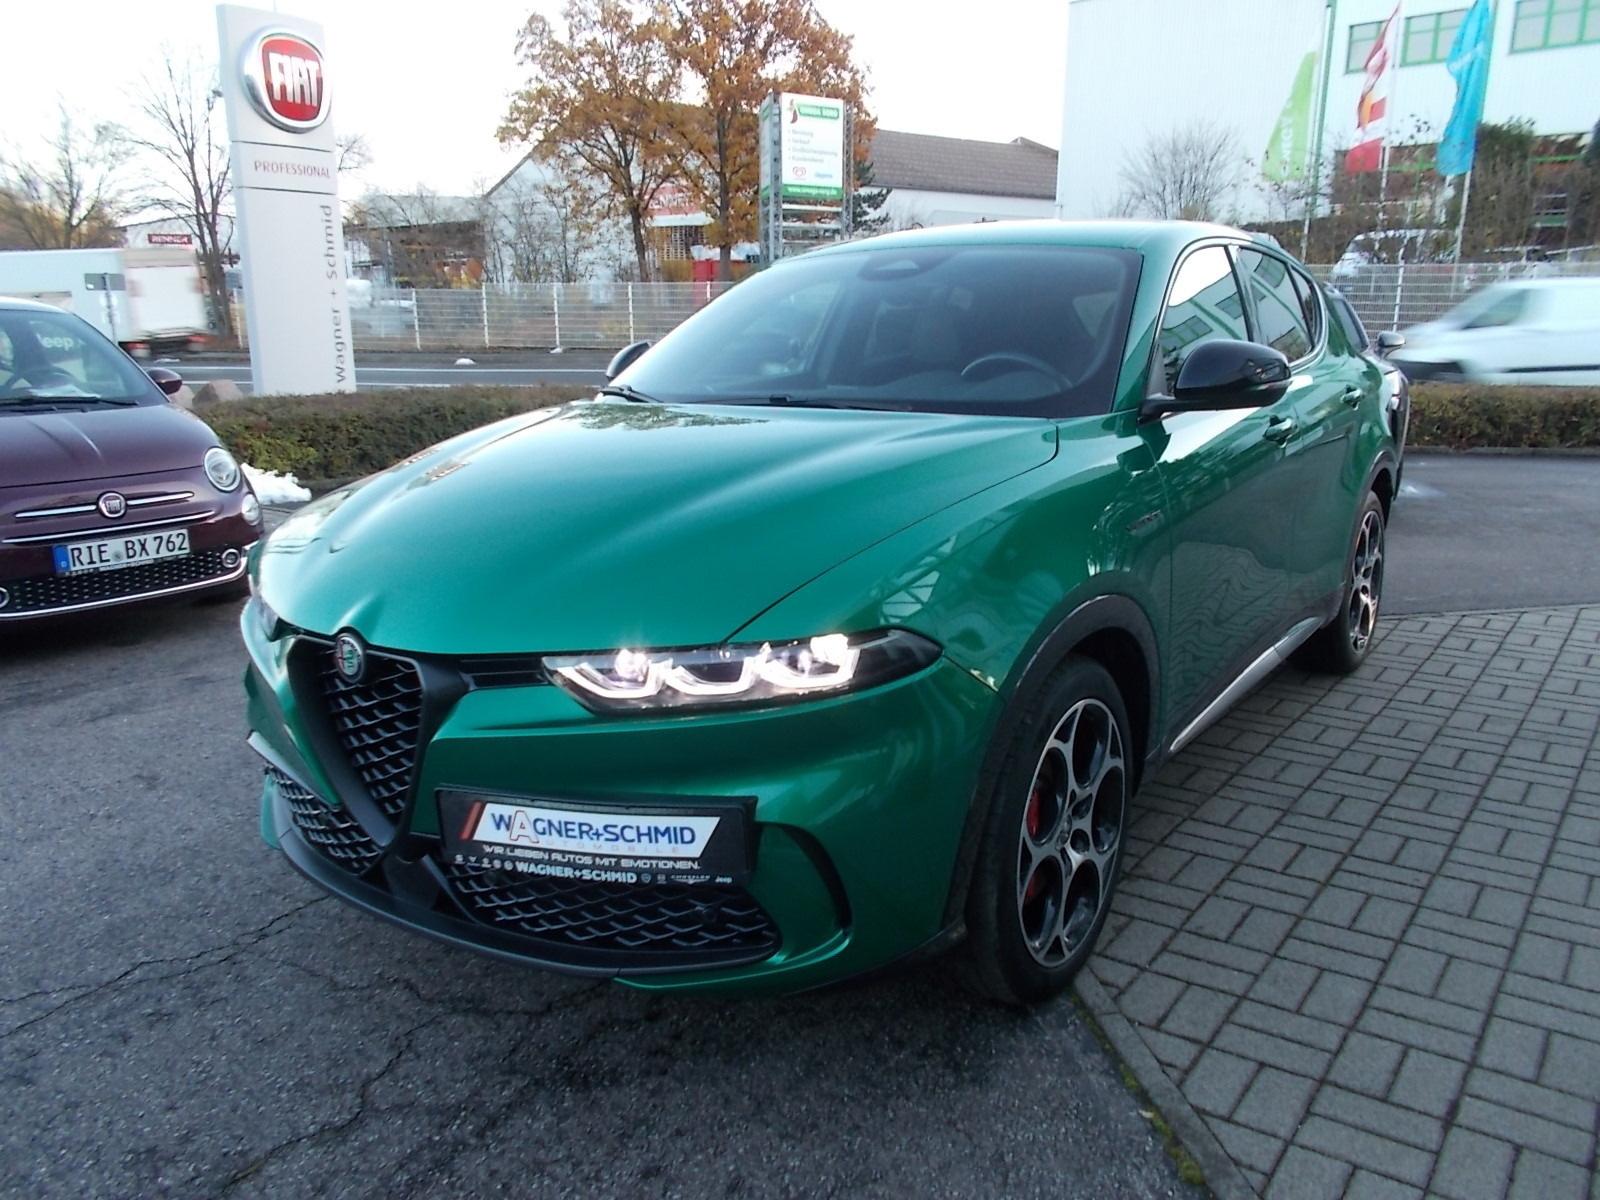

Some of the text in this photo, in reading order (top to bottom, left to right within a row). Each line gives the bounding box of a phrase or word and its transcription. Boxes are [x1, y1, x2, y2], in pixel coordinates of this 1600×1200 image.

[268, 52, 320, 107] FIAT
[254, 159, 331, 179] PROFESSIONAL
[320, 204, 338, 280] Schmid
[70, 543, 110, 567] RIE
[491, 809, 696, 845] WAGNER+SCHMID
[482, 844, 701, 870] WIR LIEBEN AUTOS MIT EMOTIONEN.
[515, 861, 637, 884] WAGNER+SCHMID
